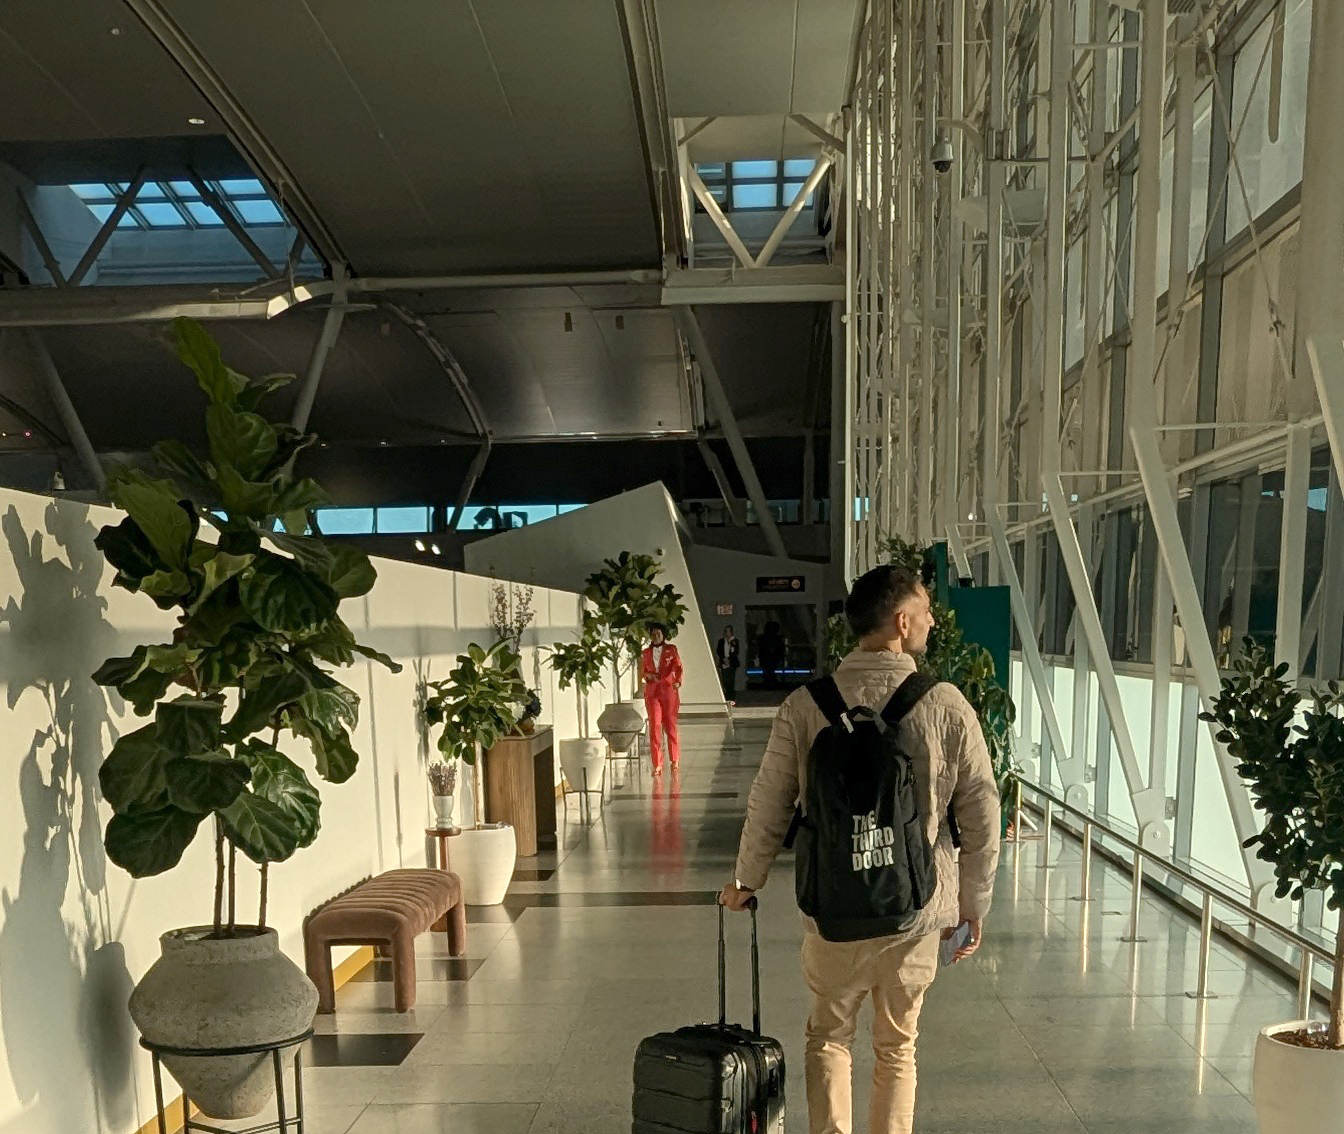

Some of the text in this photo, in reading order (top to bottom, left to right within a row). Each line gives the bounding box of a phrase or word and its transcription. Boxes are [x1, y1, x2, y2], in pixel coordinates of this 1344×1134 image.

[852, 810, 877, 834] THE
[851, 826, 895, 852] THIRD
[851, 846, 895, 872] DOOR
